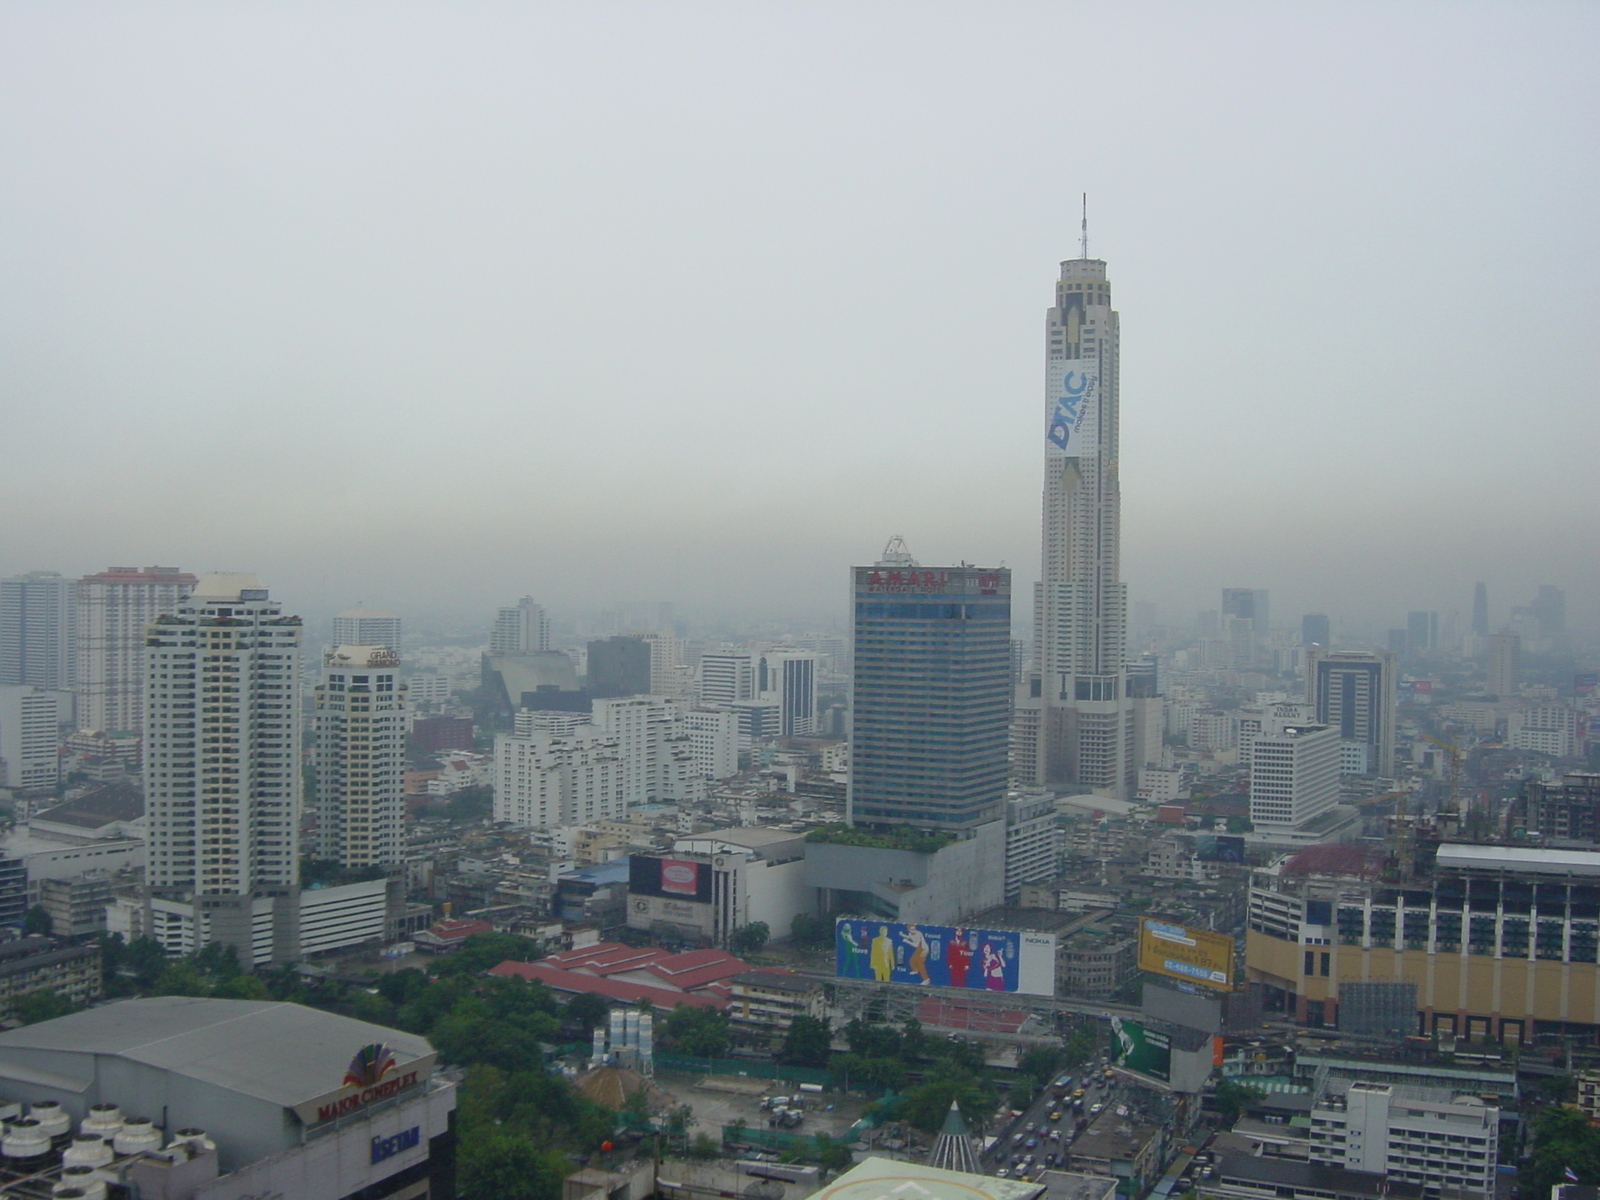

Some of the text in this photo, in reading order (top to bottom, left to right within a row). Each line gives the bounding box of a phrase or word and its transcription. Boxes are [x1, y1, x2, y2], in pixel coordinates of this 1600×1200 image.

[1048, 371, 1087, 451] DTAC
[1074, 404, 1087, 434] makes
[870, 571, 946, 586] AMARI
[367, 659, 401, 668] DIAMOND
[370, 651, 397, 660] GRAND
[318, 1071, 418, 1120] MAJOR CINEPLEX
